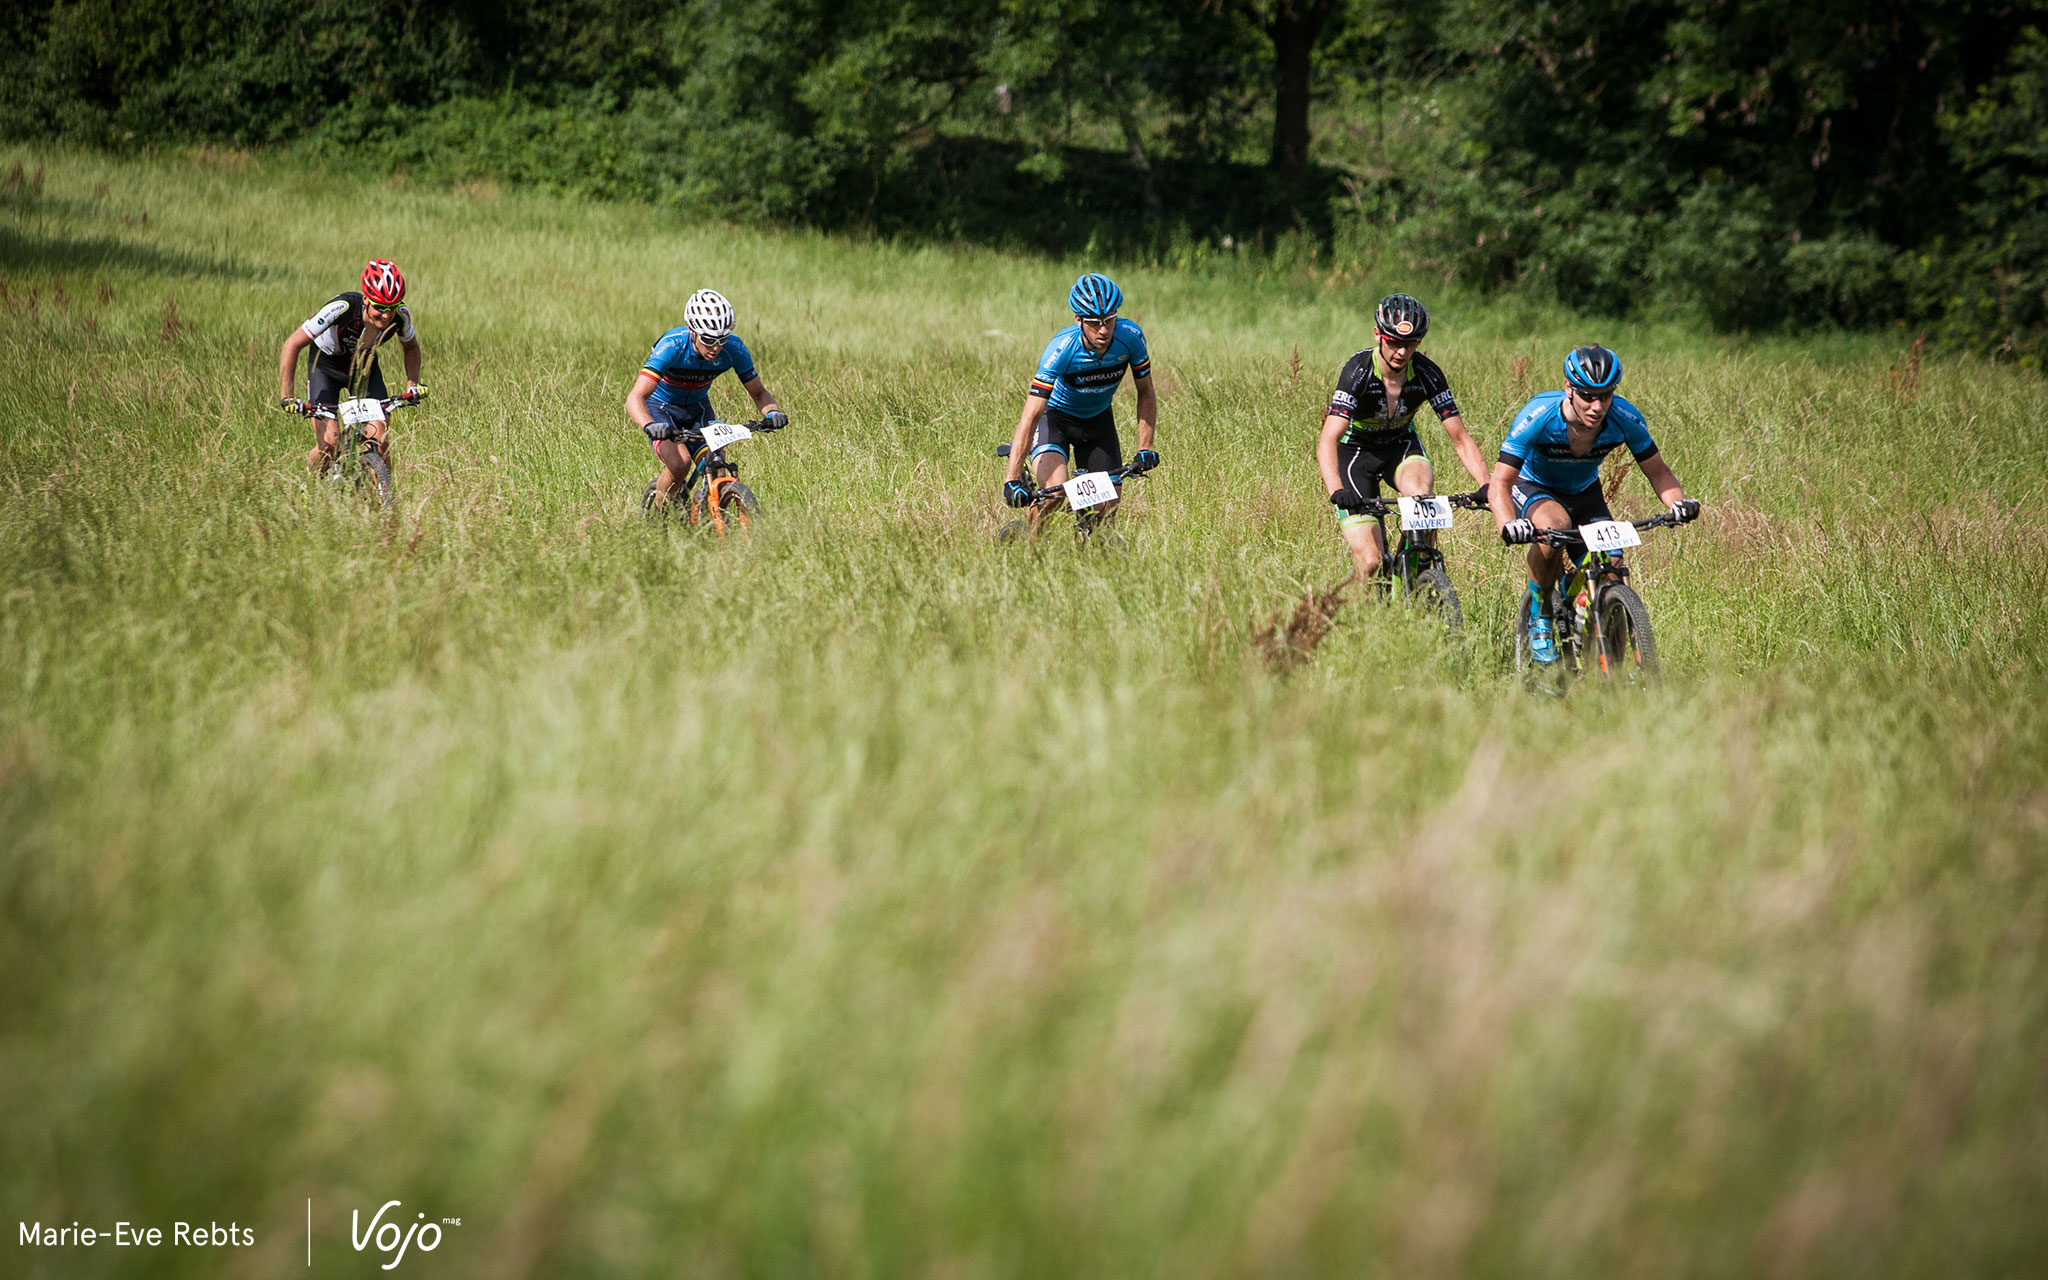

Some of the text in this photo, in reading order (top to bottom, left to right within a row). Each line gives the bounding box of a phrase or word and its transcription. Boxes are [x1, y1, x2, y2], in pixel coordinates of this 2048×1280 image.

[713, 425, 733, 437] 400
[1076, 479, 1097, 497] 409
[1076, 490, 1111, 507] VALVERT
[1413, 501, 1436, 518] 405
[1409, 518, 1446, 529] VALVERT
[1597, 525, 1620, 542] 413
